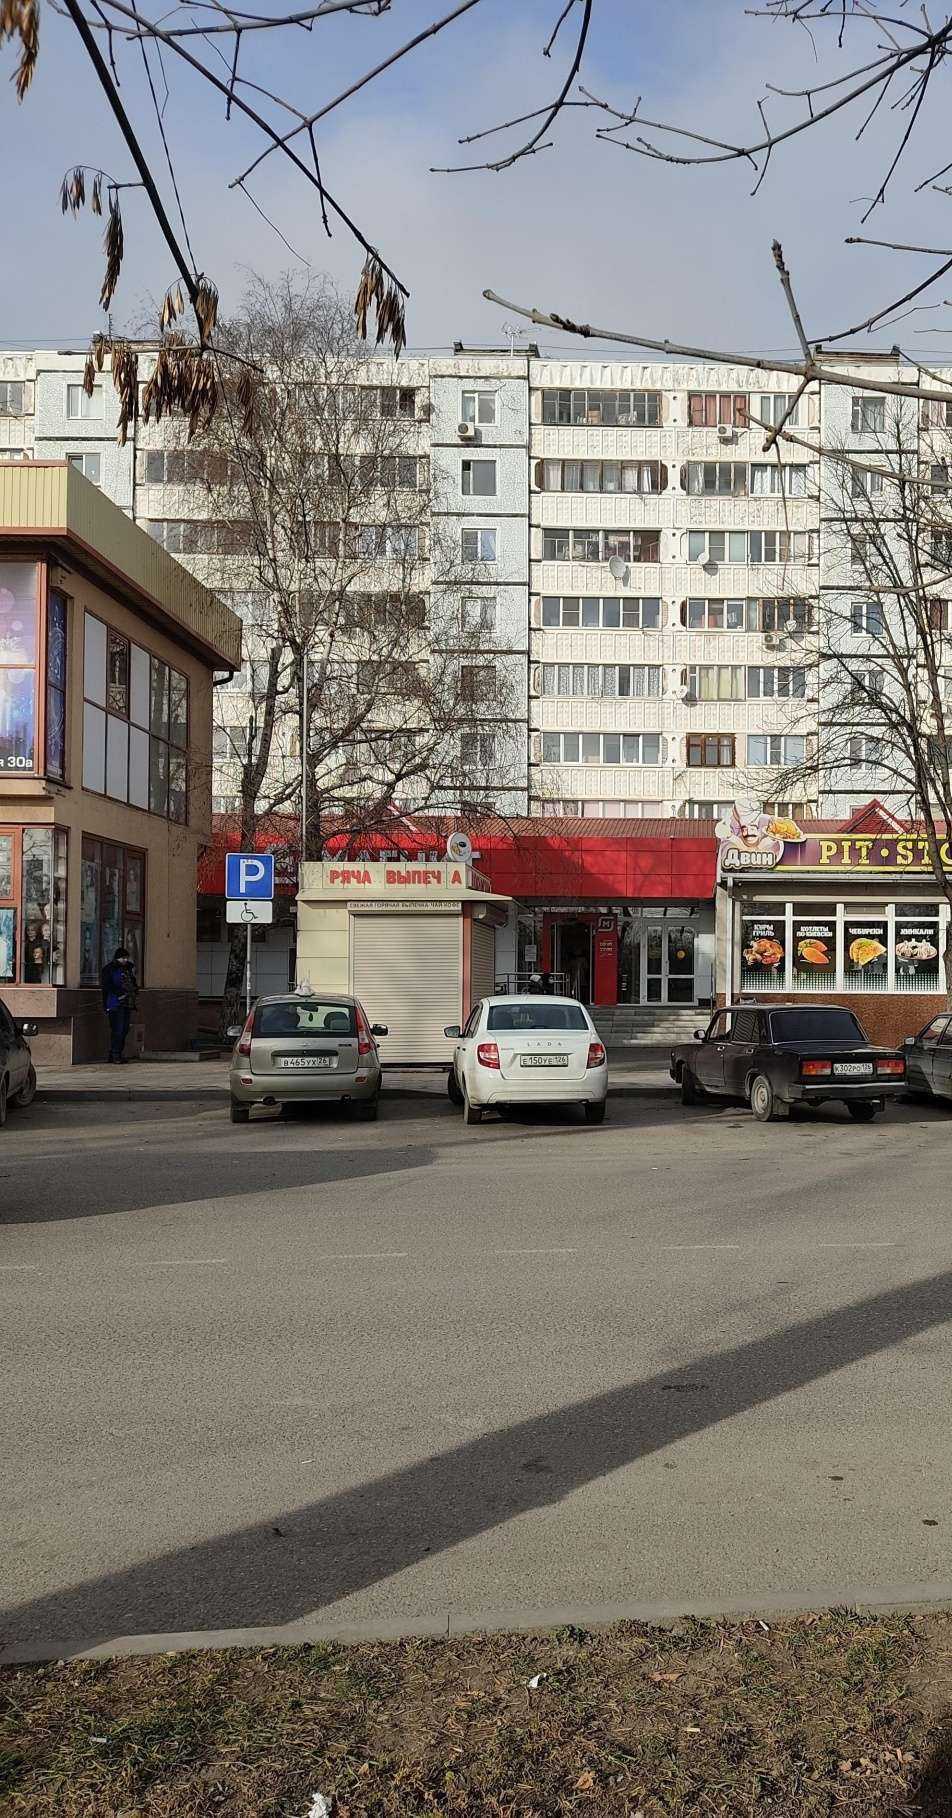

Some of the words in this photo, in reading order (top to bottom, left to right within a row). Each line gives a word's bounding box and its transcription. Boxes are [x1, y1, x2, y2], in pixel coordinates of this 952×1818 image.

[724, 848, 773, 867] Двин
[819, 841, 873, 865] PIT
[239, 858, 265, 894] P
